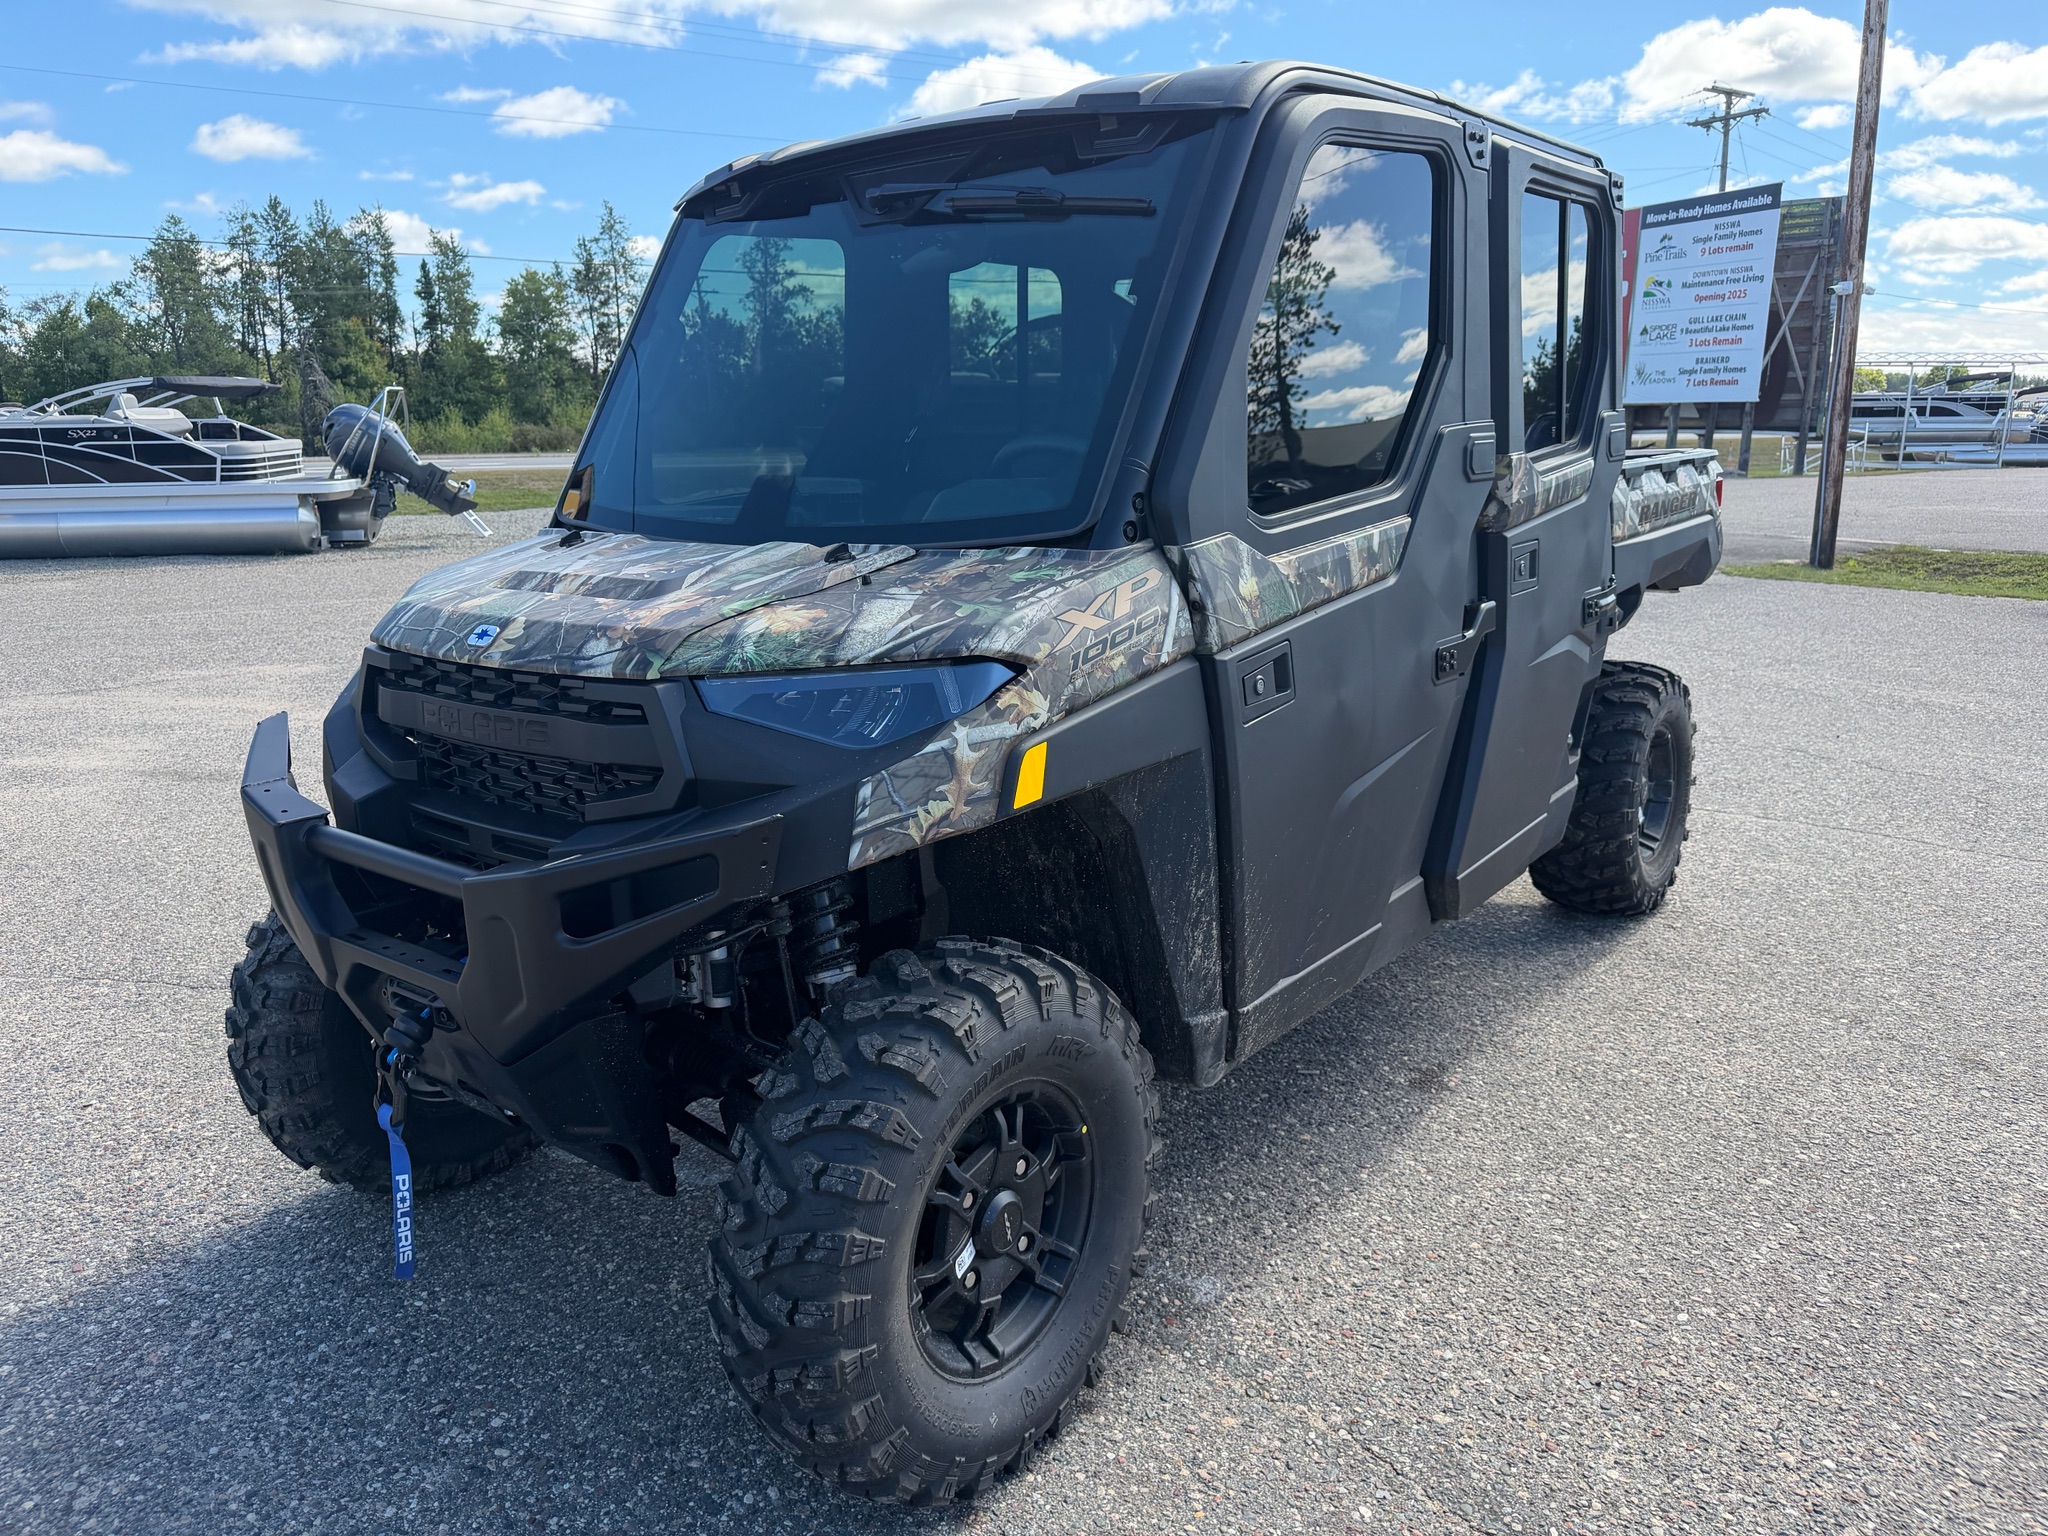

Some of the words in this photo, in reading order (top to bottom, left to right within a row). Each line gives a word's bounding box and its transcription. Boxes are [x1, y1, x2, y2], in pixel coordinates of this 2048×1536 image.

[1646, 206, 1703, 224] Move-in-Ready
[1704, 202, 1731, 215] Homes
[1732, 194, 1772, 210] Available
[1714, 220, 1741, 231] NISSWA
[1692, 234, 1713, 245] Single
[1714, 231, 1737, 244] Family
[1738, 228, 1763, 238] Homes
[1644, 252, 1663, 263] Pine
[1664, 248, 1687, 261] Trails
[1700, 247, 1707, 257] 9
[1708, 245, 1724, 256] Lots
[1725, 241, 1754, 253] remain
[1692, 267, 1728, 279] DOWNTOWN
[1730, 265, 1754, 275] NISSWA
[1681, 278, 1725, 289] Maintenance
[1726, 276, 1741, 285] Free
[1742, 274, 1764, 284] Living
[1641, 297, 1671, 306] NISSWA
[1694, 291, 1726, 304] Opening
[1727, 289, 1748, 299] 2025
[1688, 315, 1705, 325] GULL
[1706, 314, 1724, 323] LAKE
[1724, 313, 1747, 321] CHAIN
[1649, 323, 1677, 332] SPIDER
[1684, 326, 1714, 335] Beautiful
[1731, 323, 1754, 331] Homes
[1648, 331, 1676, 341] LAKE
[1688, 338, 1694, 347] 3
[1695, 337, 1711, 347] Lots
[1712, 335, 1743, 346] Remain
[1695, 356, 1730, 365] BRAINERD
[1678, 367, 1698, 377] Single
[1699, 366, 1721, 376] Family
[1722, 365, 1747, 373] Homes
[1686, 379, 1691, 387] 7
[1693, 378, 1708, 387] Lots
[1709, 376, 1739, 387] Remain
[1638, 492, 1699, 526] RANGER
[1046, 567, 1164, 658] XP
[1069, 606, 1162, 676] 1000
[421, 701, 550, 749] POLARIS
[395, 1173, 413, 1264] POLARIS
